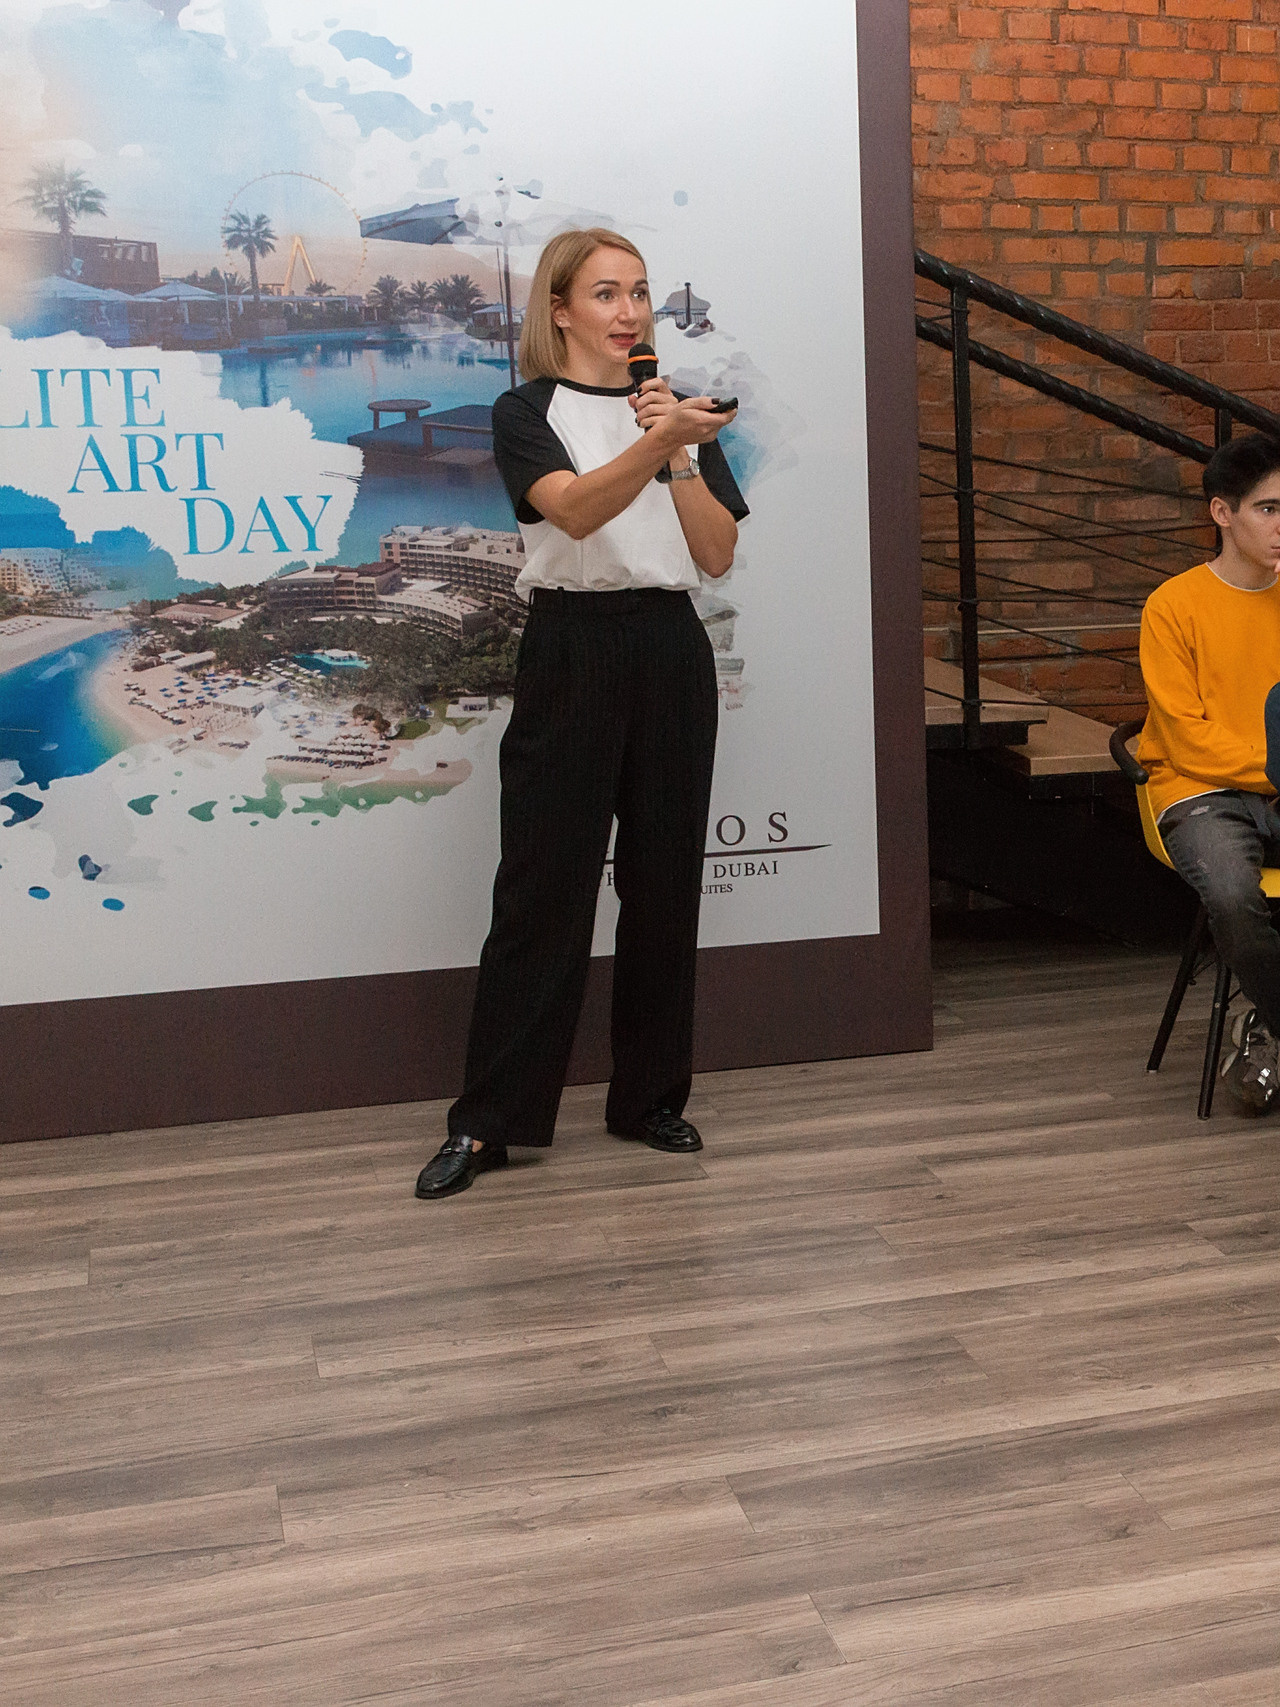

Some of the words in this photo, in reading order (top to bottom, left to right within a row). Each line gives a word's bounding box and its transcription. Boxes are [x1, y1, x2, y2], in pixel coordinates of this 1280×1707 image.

[67, 433, 224, 493] ART
[179, 495, 332, 555] DAY
[715, 811, 789, 846] OS
[713, 860, 779, 879] DUBAI
[700, 883, 733, 895] UITES
